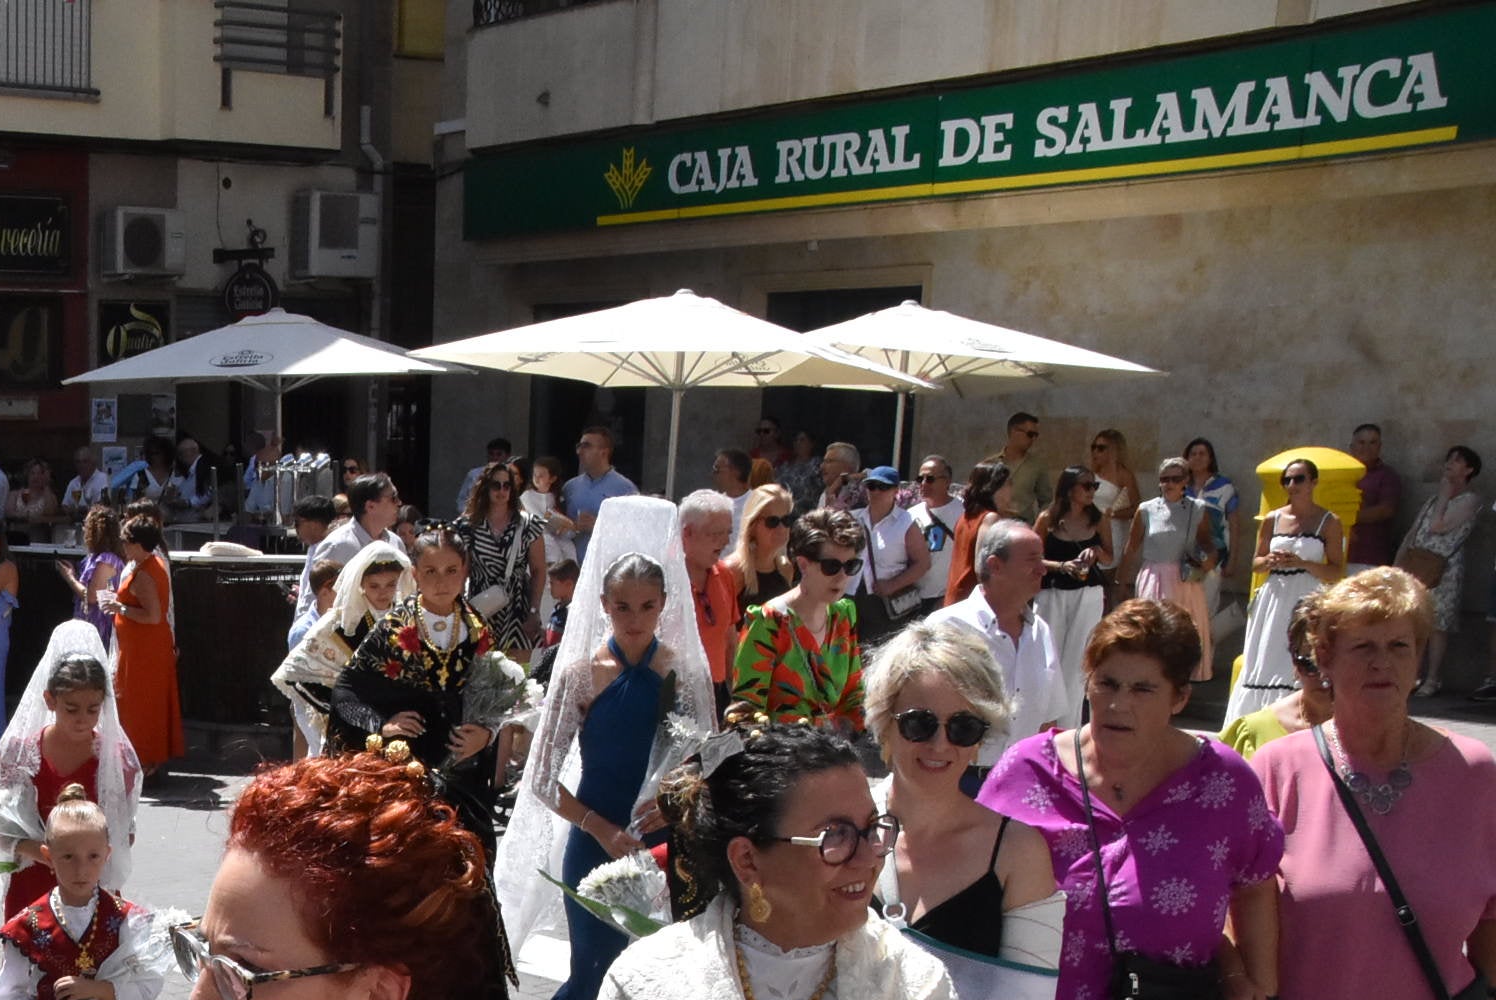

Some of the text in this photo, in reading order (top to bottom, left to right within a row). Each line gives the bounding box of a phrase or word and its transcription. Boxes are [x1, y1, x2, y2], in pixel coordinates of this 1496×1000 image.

[667, 51, 1449, 194] CAJA RURAL DE SALAMANCA
